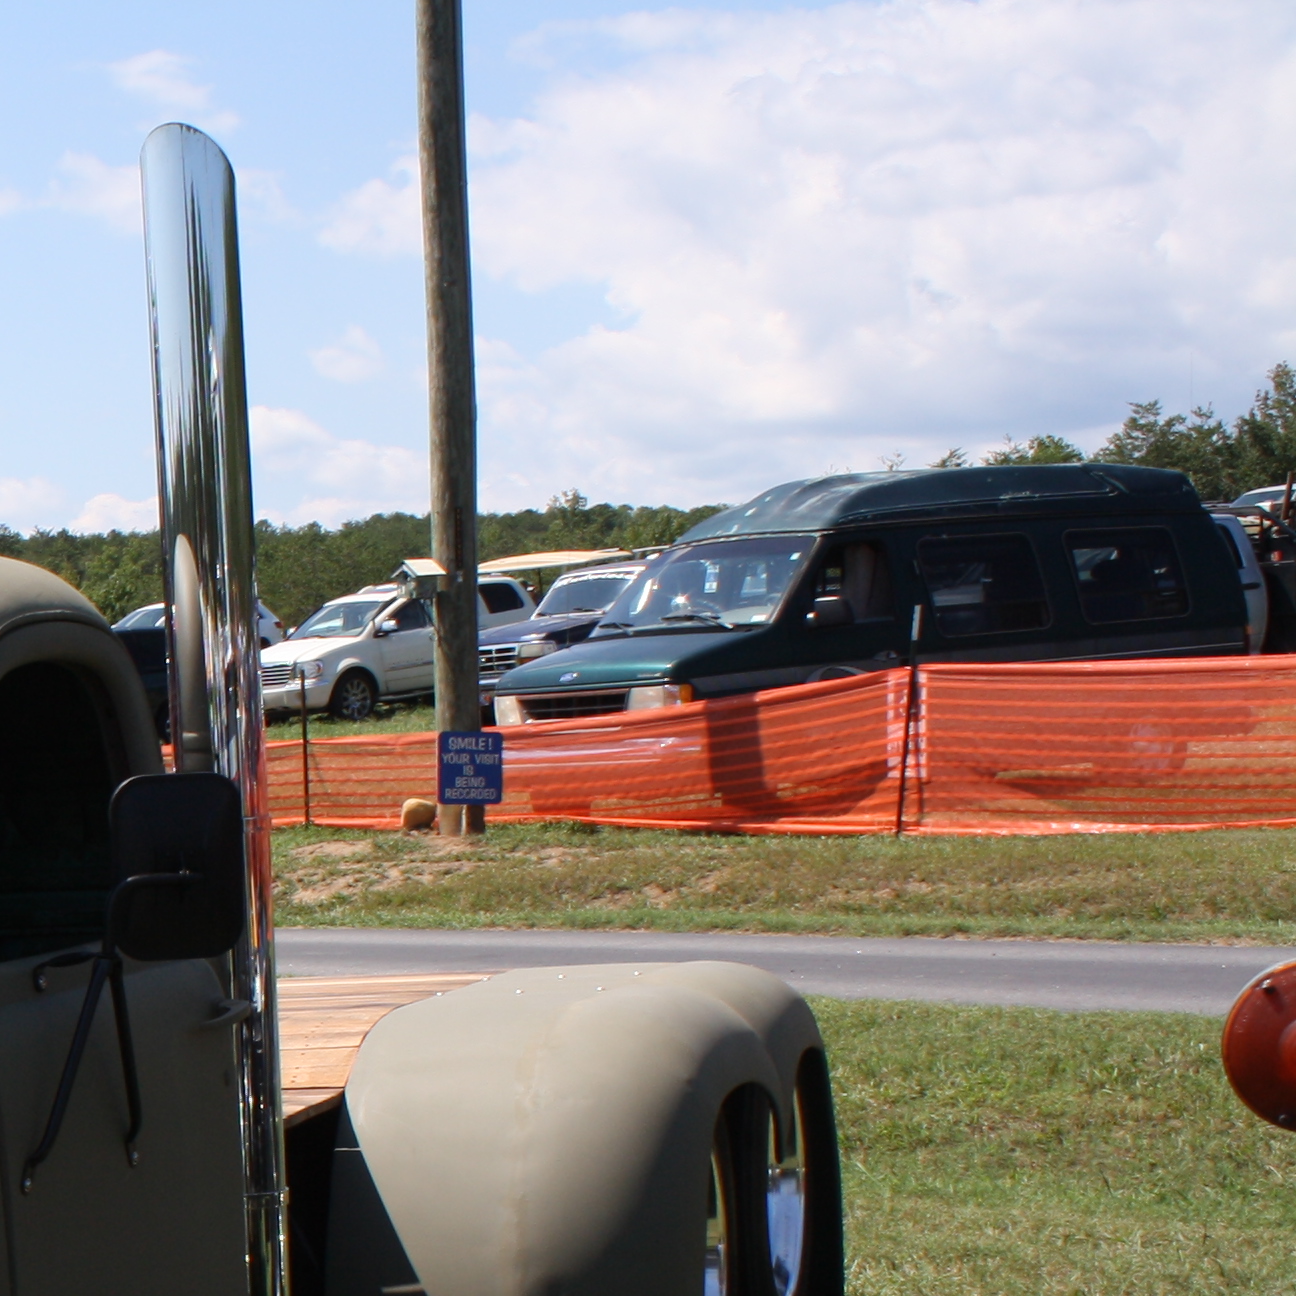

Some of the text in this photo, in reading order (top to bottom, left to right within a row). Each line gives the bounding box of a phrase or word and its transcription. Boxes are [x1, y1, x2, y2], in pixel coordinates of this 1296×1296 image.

[441, 753, 500, 765] YOUR VISIT
[462, 765, 474, 776] IS
[455, 777, 486, 788] BEING
[444, 788, 497, 800] RECORDED
